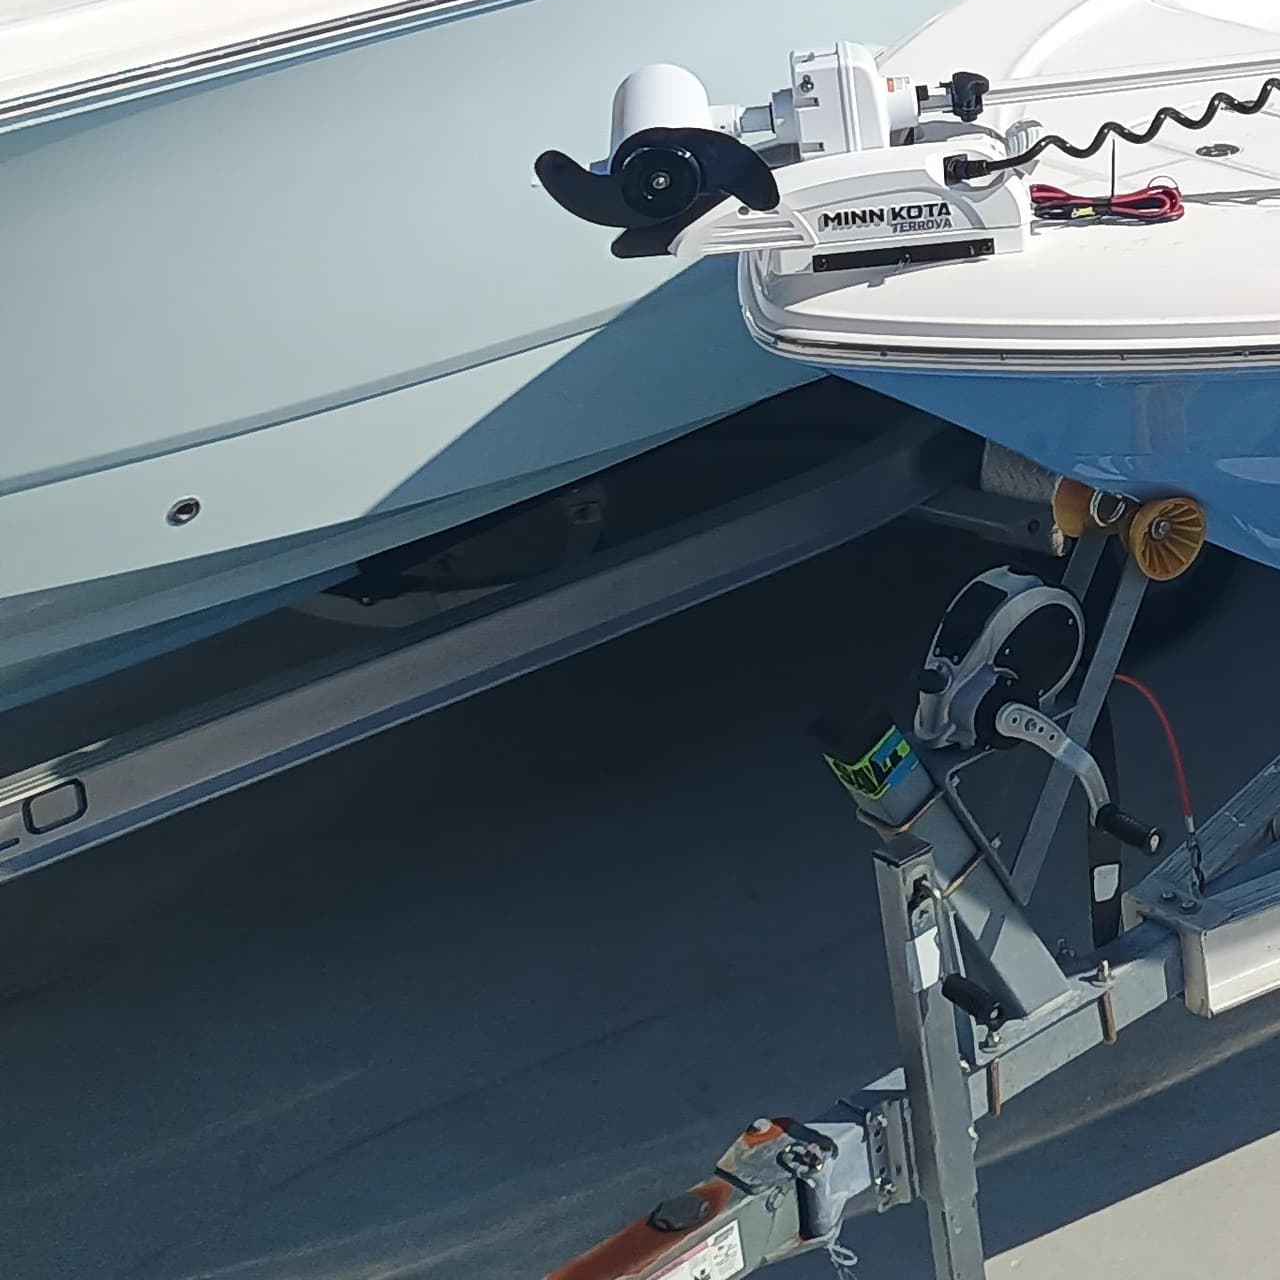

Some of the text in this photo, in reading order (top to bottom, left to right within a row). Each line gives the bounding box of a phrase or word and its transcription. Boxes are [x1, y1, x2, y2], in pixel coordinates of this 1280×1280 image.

[821, 202, 952, 229] MINN KOTA
[891, 218, 953, 234] TERROVA
